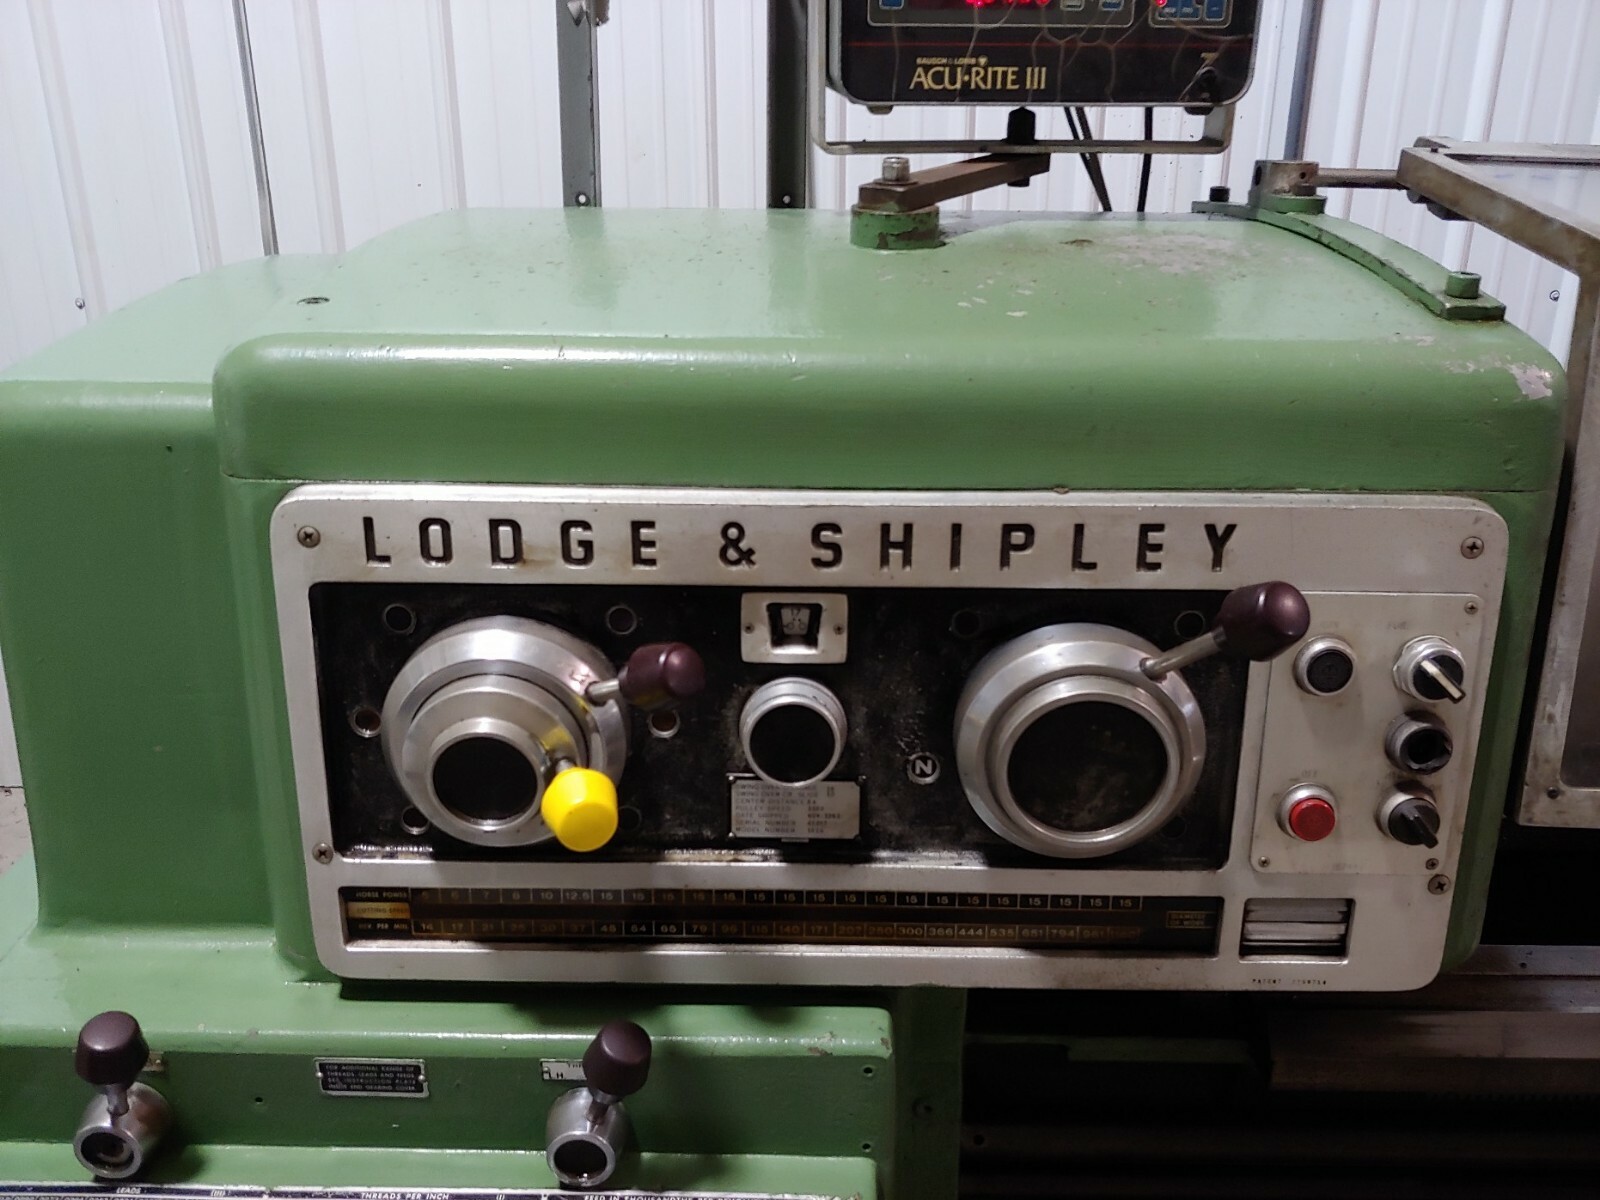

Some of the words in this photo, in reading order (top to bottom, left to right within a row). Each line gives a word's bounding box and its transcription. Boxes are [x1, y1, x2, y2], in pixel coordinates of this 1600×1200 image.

[1025, 66, 1046, 90] III
[362, 515, 659, 568] LODGE
[718, 521, 757, 568] &
[810, 522, 1238, 572] SHIPLEY
[915, 759, 933, 775] N
[899, 927, 923, 936] 300
[958, 928, 983, 937] 444
[1051, 930, 1074, 938] 794
